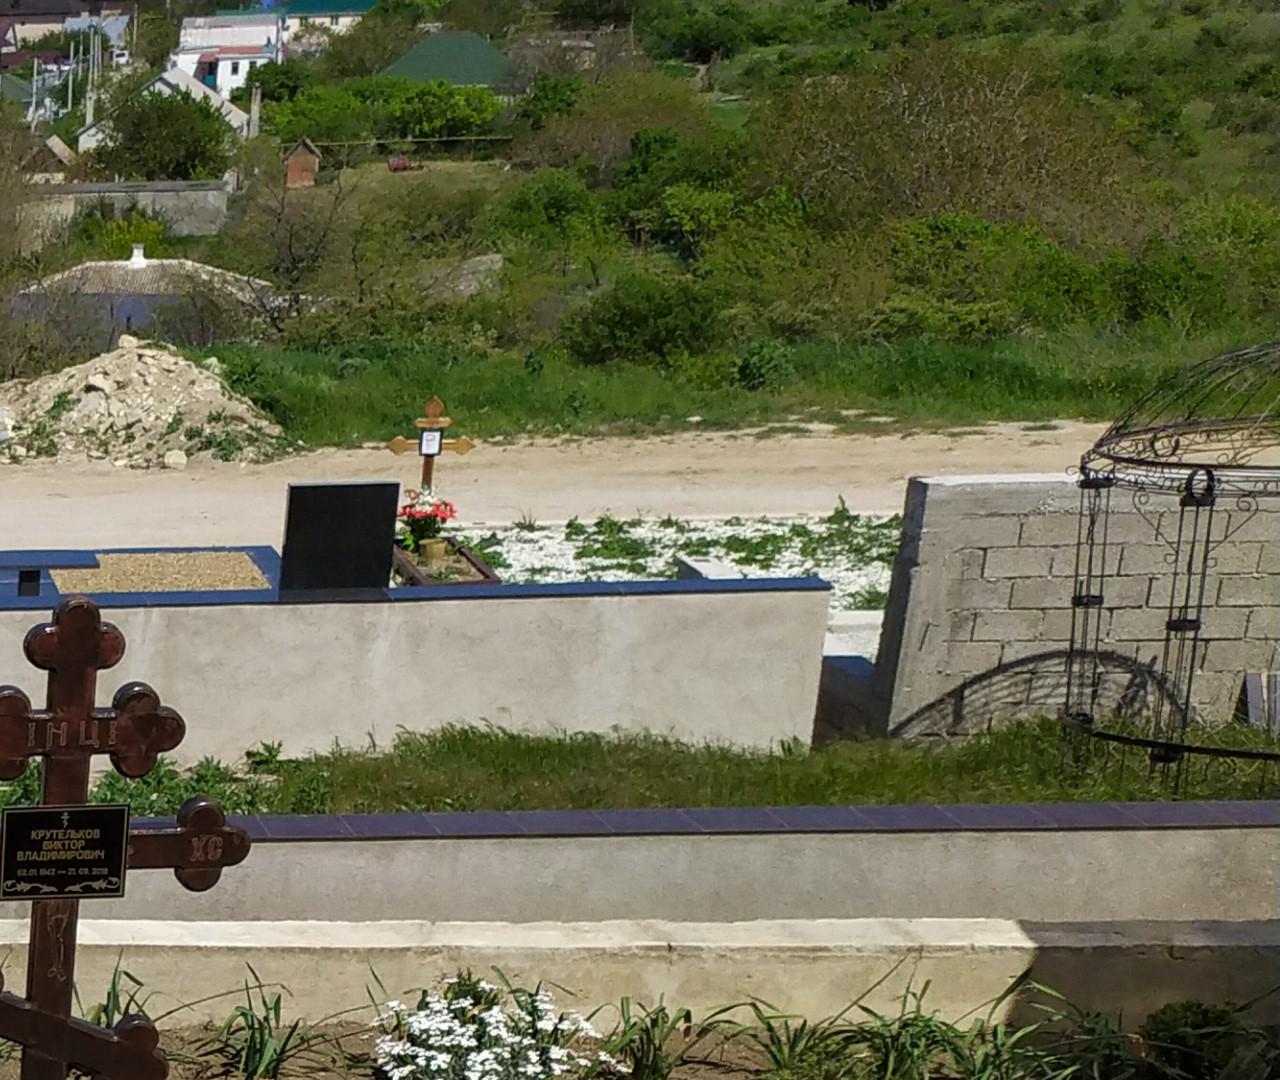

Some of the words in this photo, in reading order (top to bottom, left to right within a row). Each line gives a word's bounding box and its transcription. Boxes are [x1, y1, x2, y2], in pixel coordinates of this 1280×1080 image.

[30, 829, 101, 841] КРУТЕЛЬКОВ
[42, 840, 85, 851] ВИКТОР
[16, 850, 105, 862] ВЛАДИМИРОВИЧ
